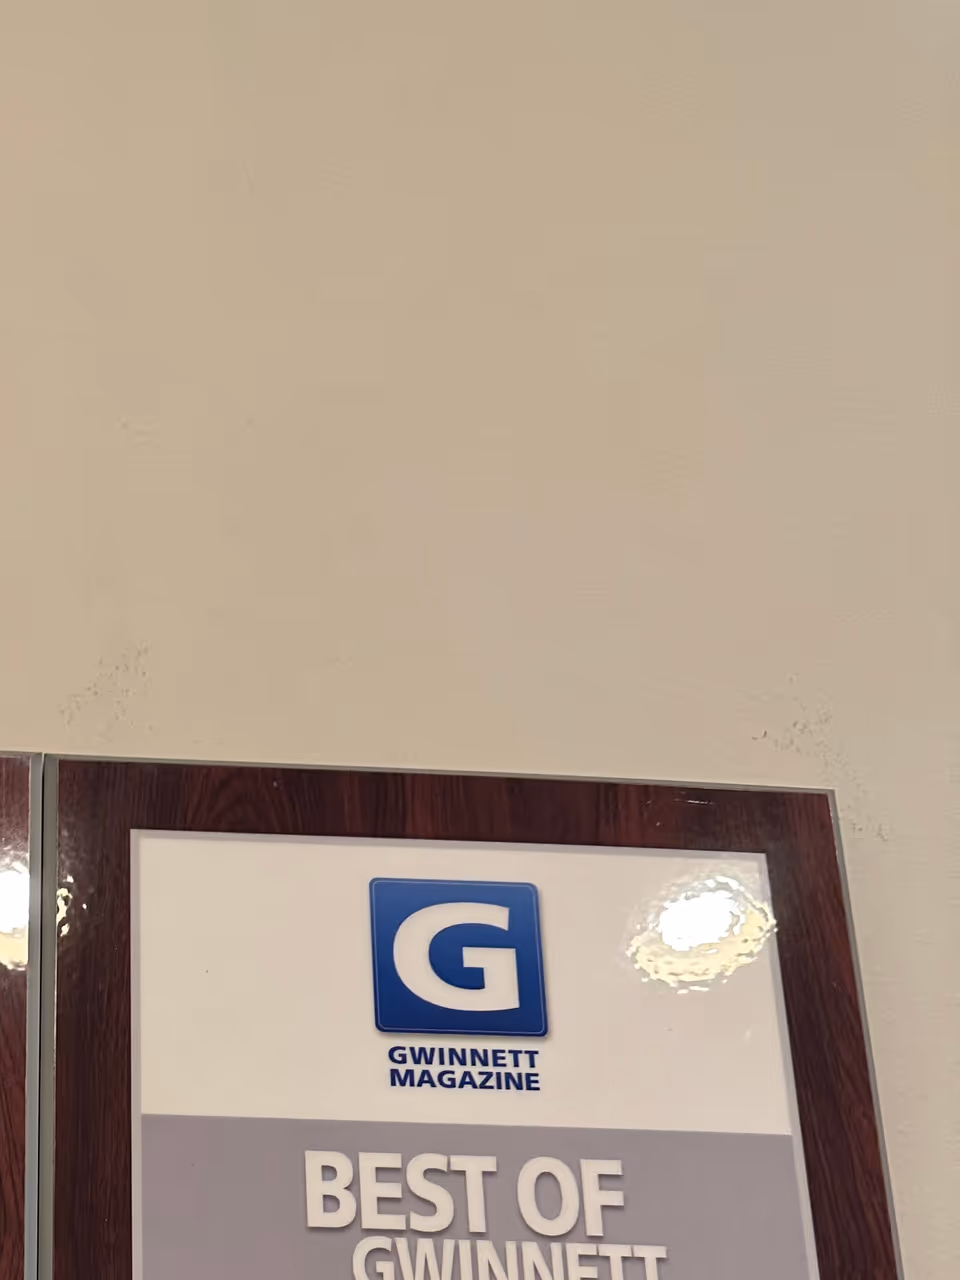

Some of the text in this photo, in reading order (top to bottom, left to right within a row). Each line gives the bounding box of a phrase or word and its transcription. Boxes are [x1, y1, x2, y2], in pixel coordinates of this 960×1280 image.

[393, 902, 520, 1012] G
[388, 1045, 539, 1068] GWINNETT
[389, 1068, 541, 1091] MAGAZINE
[304, 1150, 625, 1237] BEST OF
